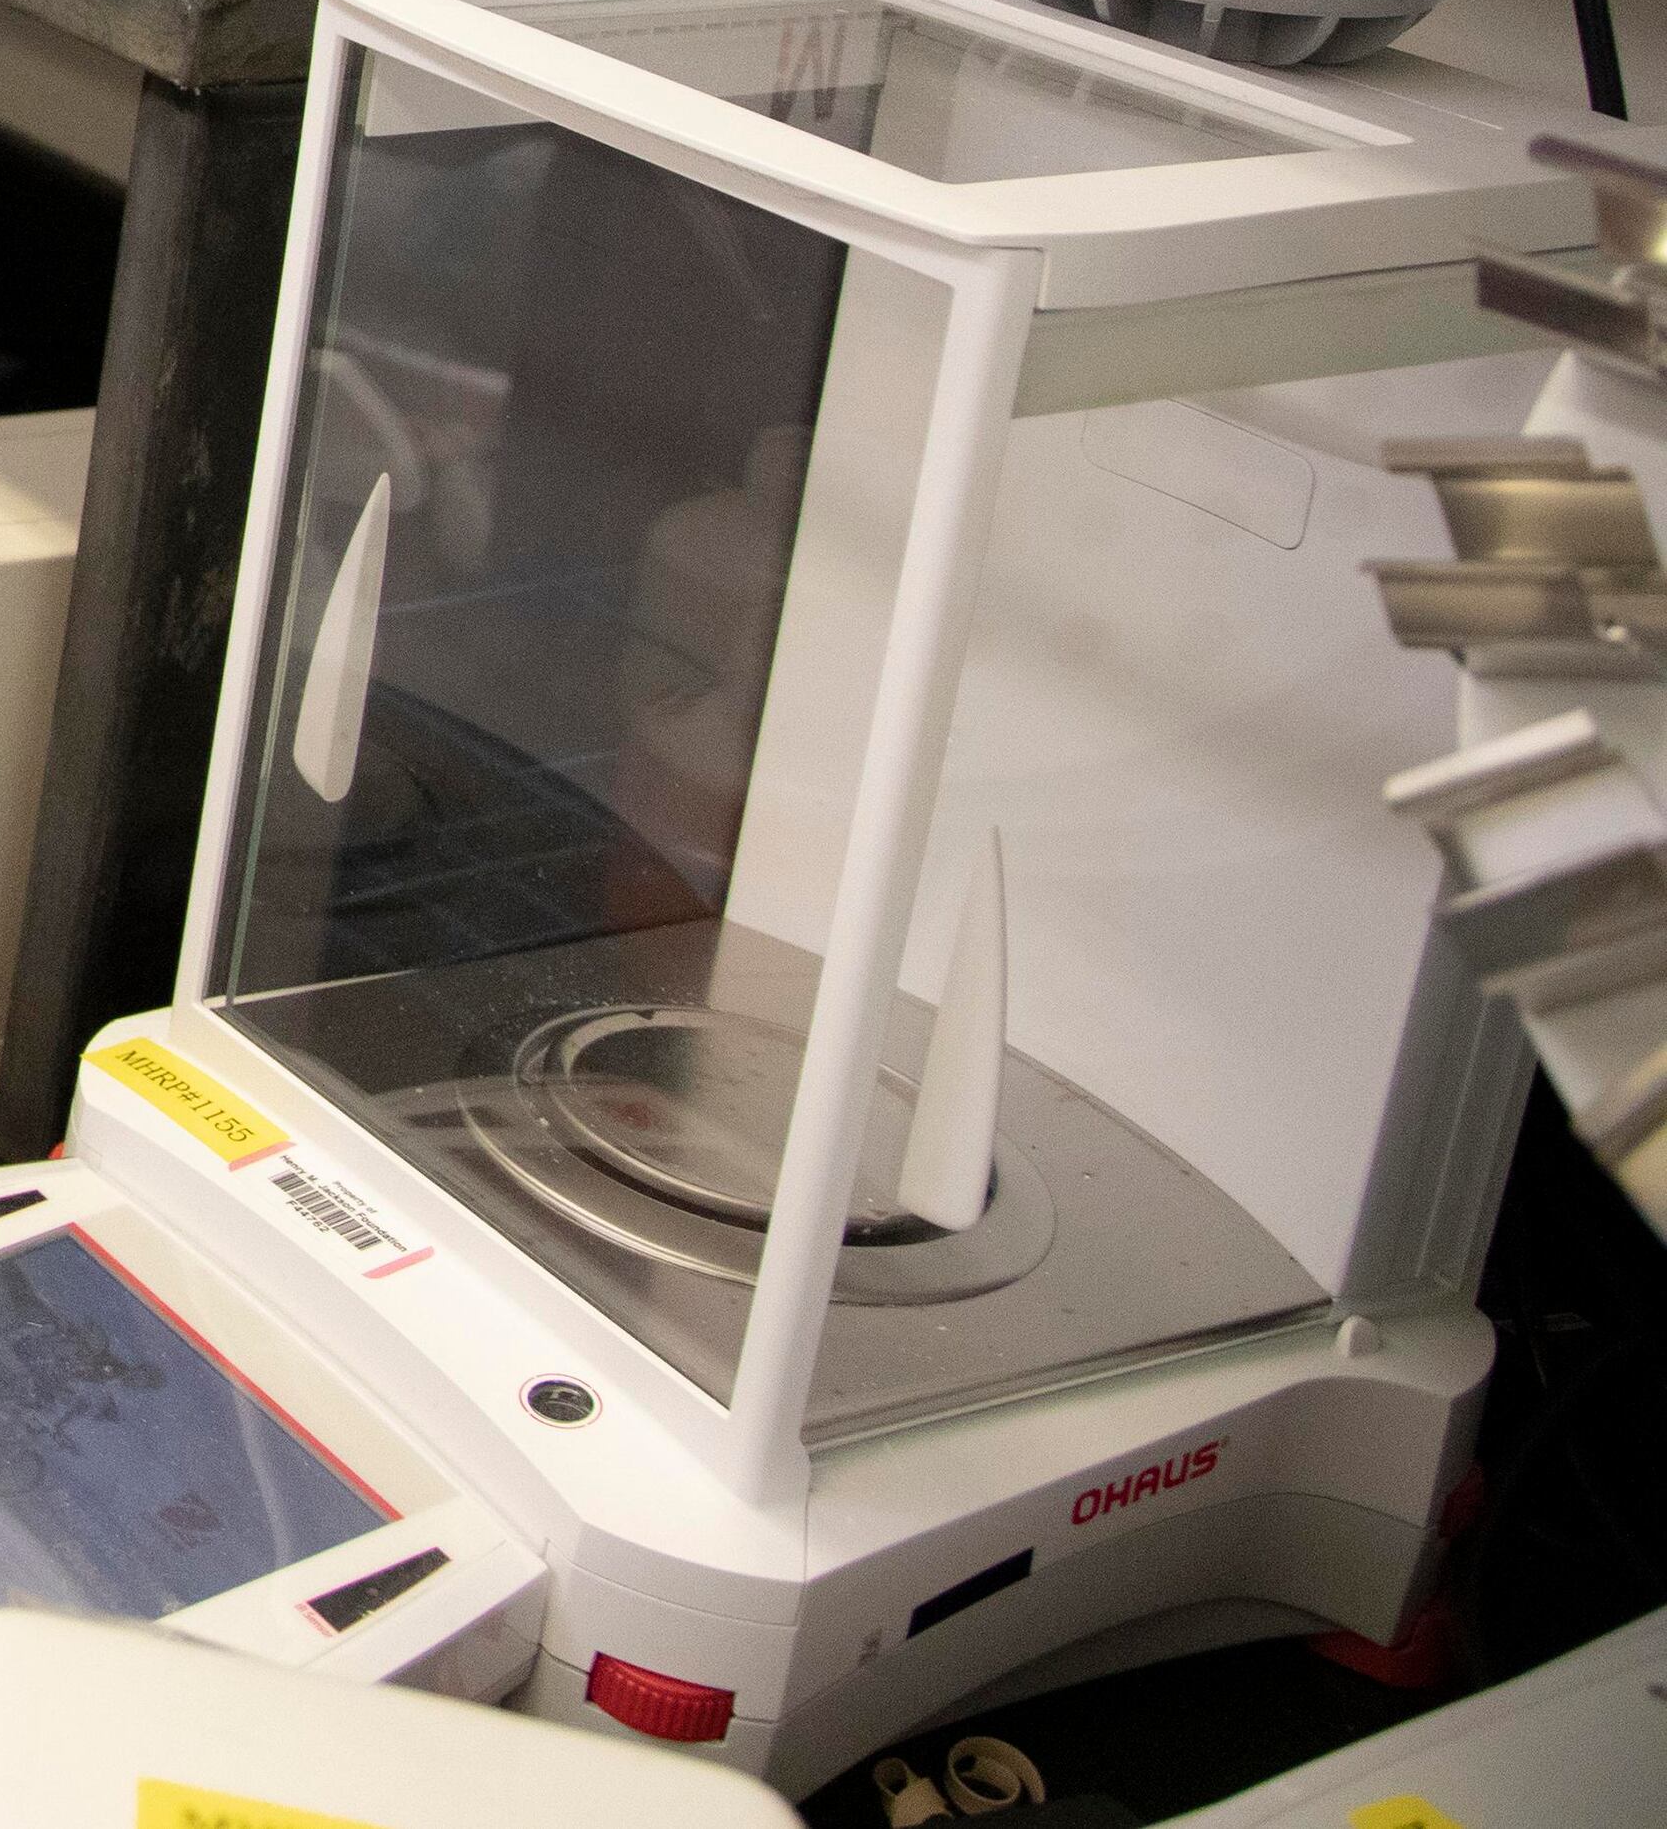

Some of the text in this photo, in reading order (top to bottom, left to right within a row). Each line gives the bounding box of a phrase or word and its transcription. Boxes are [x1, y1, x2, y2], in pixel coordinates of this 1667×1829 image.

[114, 1048, 258, 1145] MHRP#1155
[280, 1154, 307, 1175] Henry
[318, 1183, 357, 1213] Jackson
[355, 1212, 408, 1253] Foundation
[331, 1179, 367, 1207] Property
[1071, 1440, 1222, 1526] OHAUS
